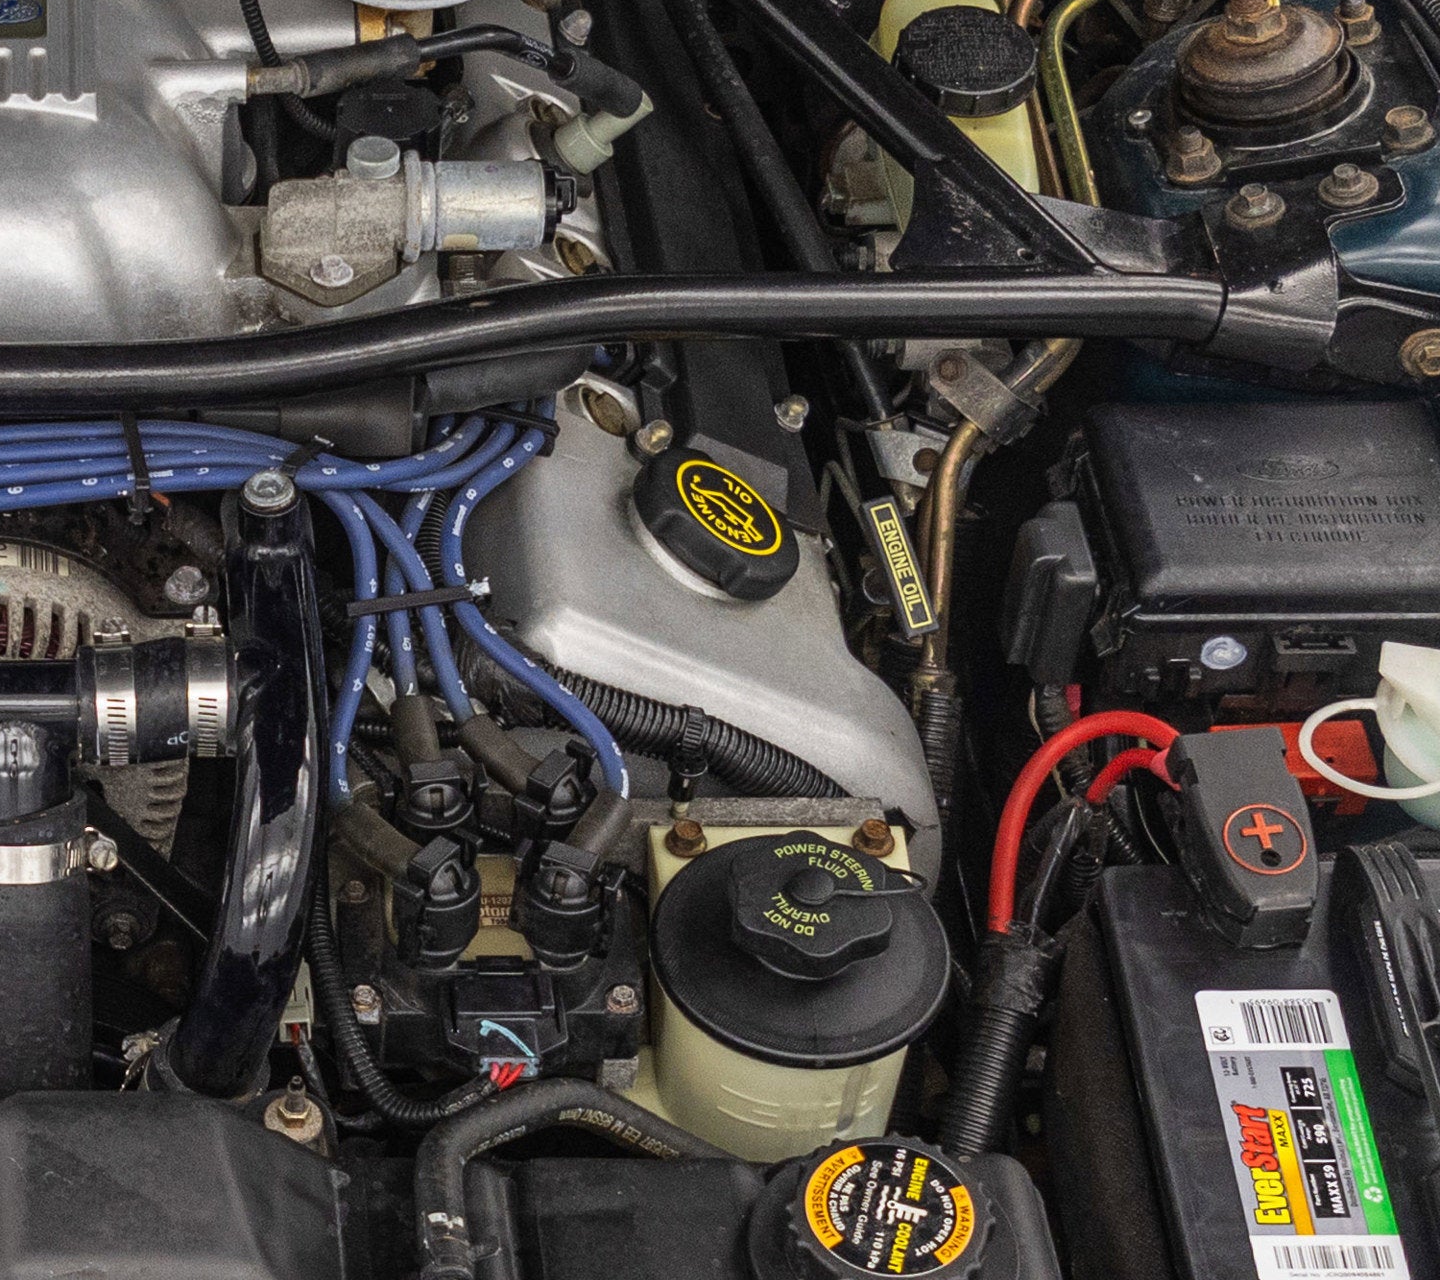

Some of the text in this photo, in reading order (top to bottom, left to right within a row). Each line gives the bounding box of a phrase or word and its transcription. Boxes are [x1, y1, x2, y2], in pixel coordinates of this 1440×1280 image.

[722, 476, 754, 506] OIL
[690, 491, 753, 545] ENGINE
[880, 518, 924, 612] ENGINE OIL
[773, 843, 875, 892] POWER STEERIN
[808, 856, 848, 879] FLUID
[762, 909, 815, 937] DO NOT
[771, 892, 831, 924] OVERFILL
[1301, 1077, 1316, 1098] 725
[1271, 1114, 1290, 1148] MAXX
[1312, 1124, 1329, 1145] 590
[831, 1163, 862, 1191] OUVRIR
[839, 1182, 856, 1212] NE PAS
[1322, 1164, 1346, 1215] MAXX 59
[812, 1156, 846, 1240] AVERTISSEMENT
[828, 1200, 846, 1231] CHAUD
[851, 1159, 883, 1245] See Owner Guide
[866, 1148, 908, 1270] 16 PSI 110 kPa
[887, 1157, 931, 1274] ENGINE COOLANT
[914, 1179, 954, 1257] DO NOT OPEN HOT
[940, 1204, 971, 1259] WARNING
